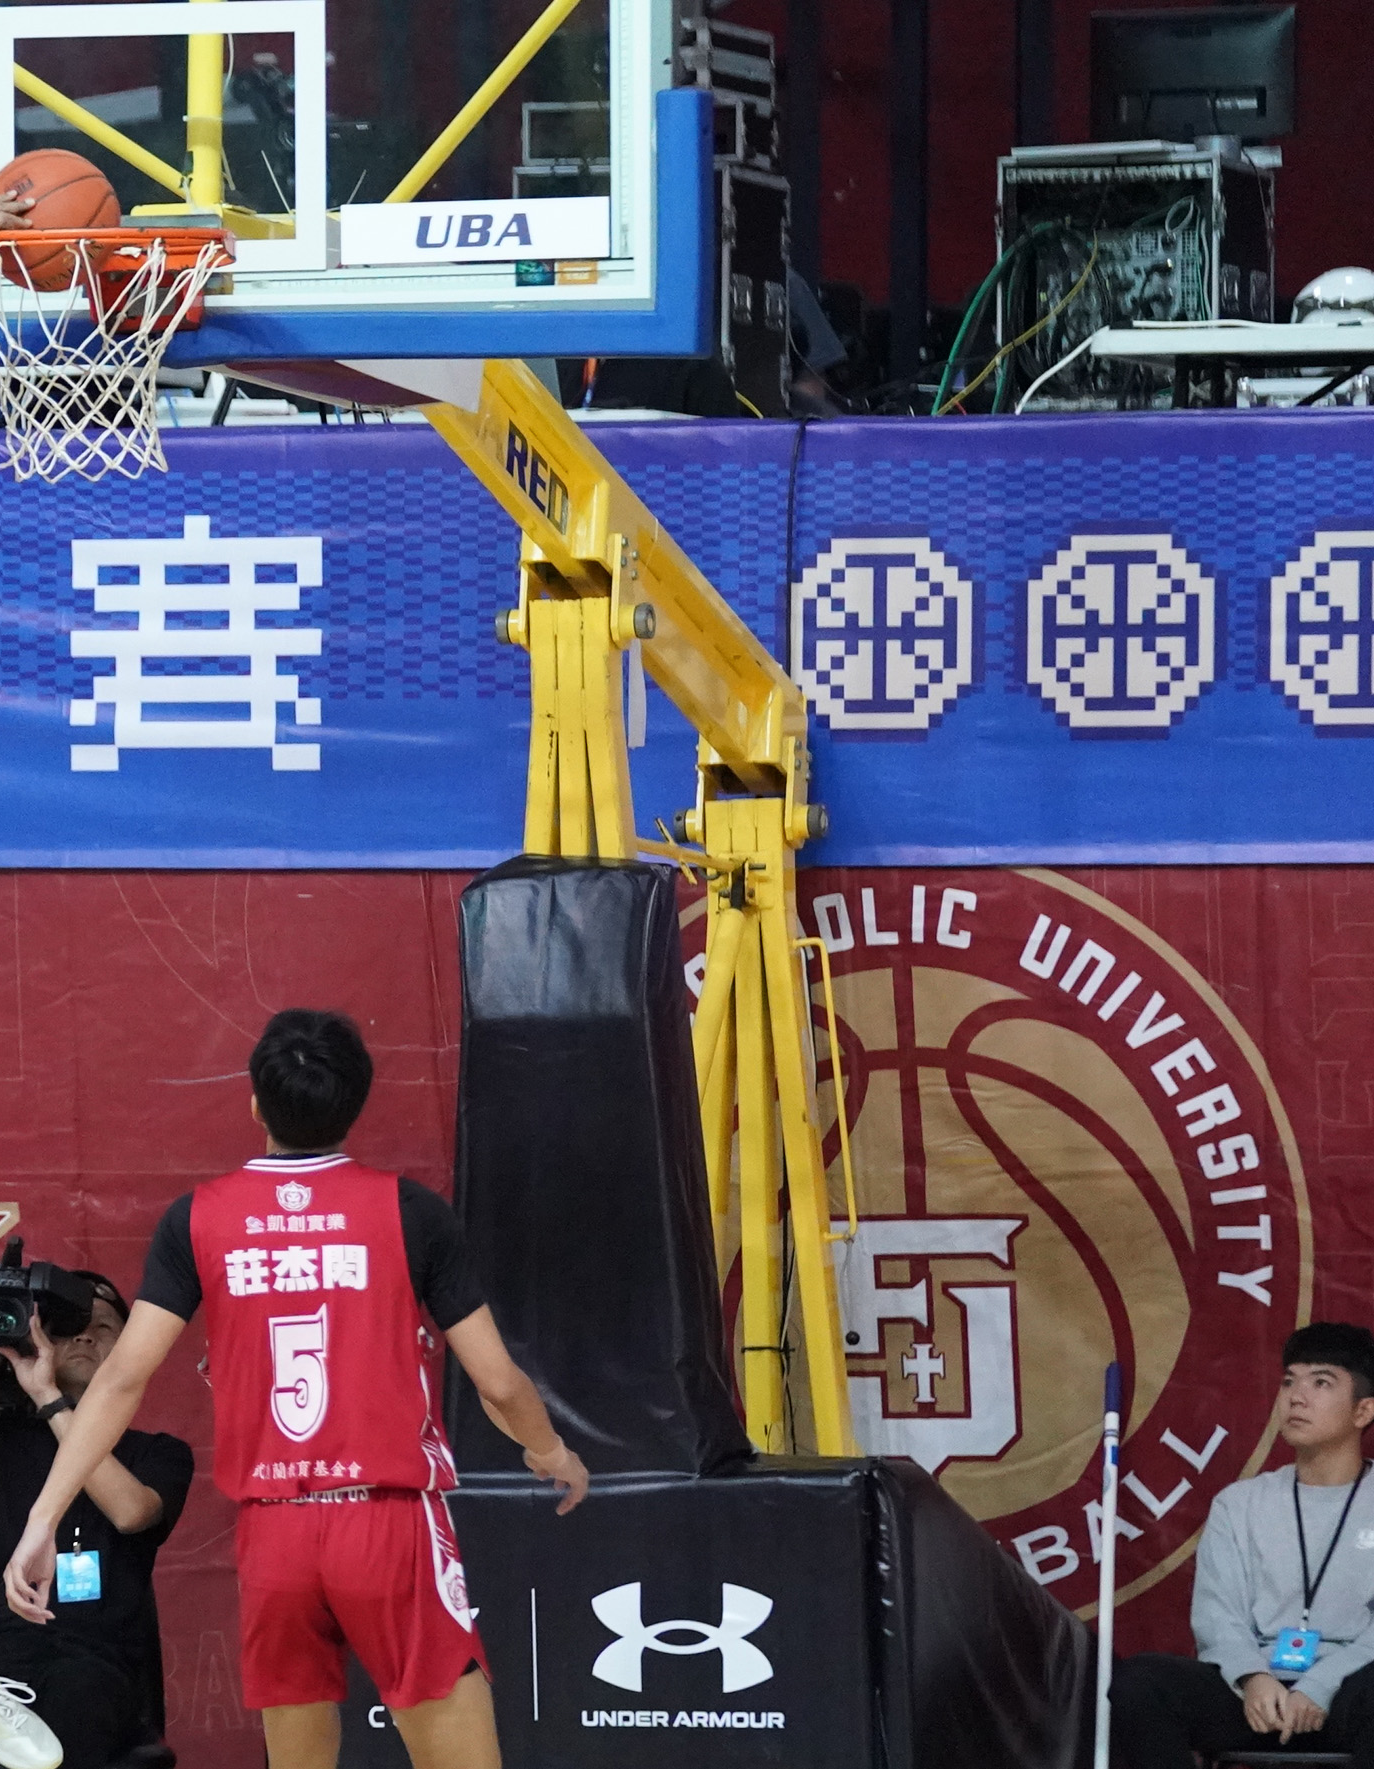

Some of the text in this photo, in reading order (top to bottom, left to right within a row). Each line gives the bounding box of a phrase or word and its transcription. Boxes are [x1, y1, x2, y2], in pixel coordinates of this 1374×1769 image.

[415, 213, 532, 249] UBA
[1019, 914, 1274, 1308] UNIVERSITY
[267, 1213, 347, 1233] 凱創實業
[267, 1303, 329, 1442] 5
[1012, 1424, 1228, 1586] BALL
[581, 1709, 785, 1729] UNDER ARMOUR
